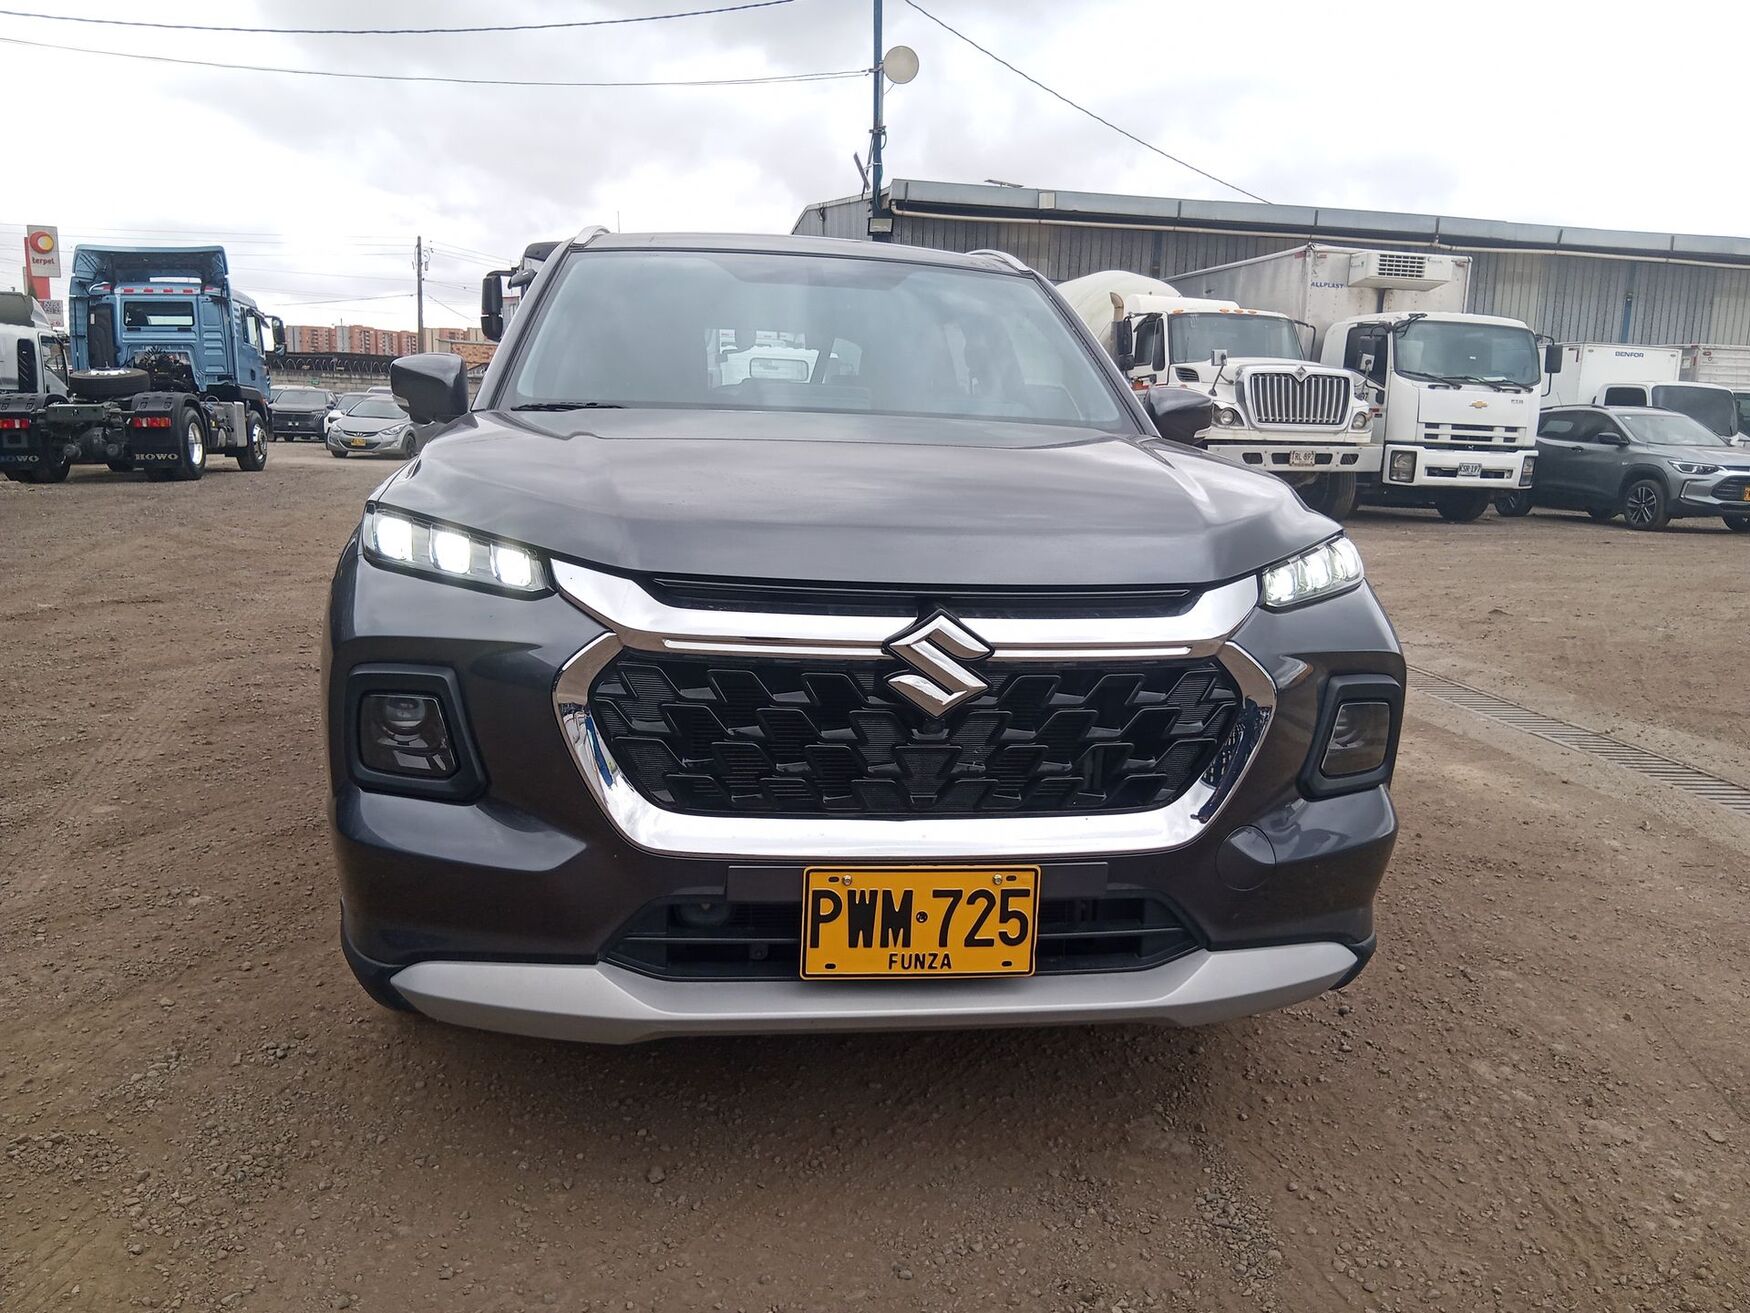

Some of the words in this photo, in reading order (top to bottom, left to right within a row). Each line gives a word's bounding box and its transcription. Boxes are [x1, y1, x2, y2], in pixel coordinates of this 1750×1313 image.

[32, 257, 55, 265] terpel
[1311, 281, 1345, 289] ALLPLAST
[135, 453, 179, 461] HOWO
[888, 952, 952, 970] FUNZA
